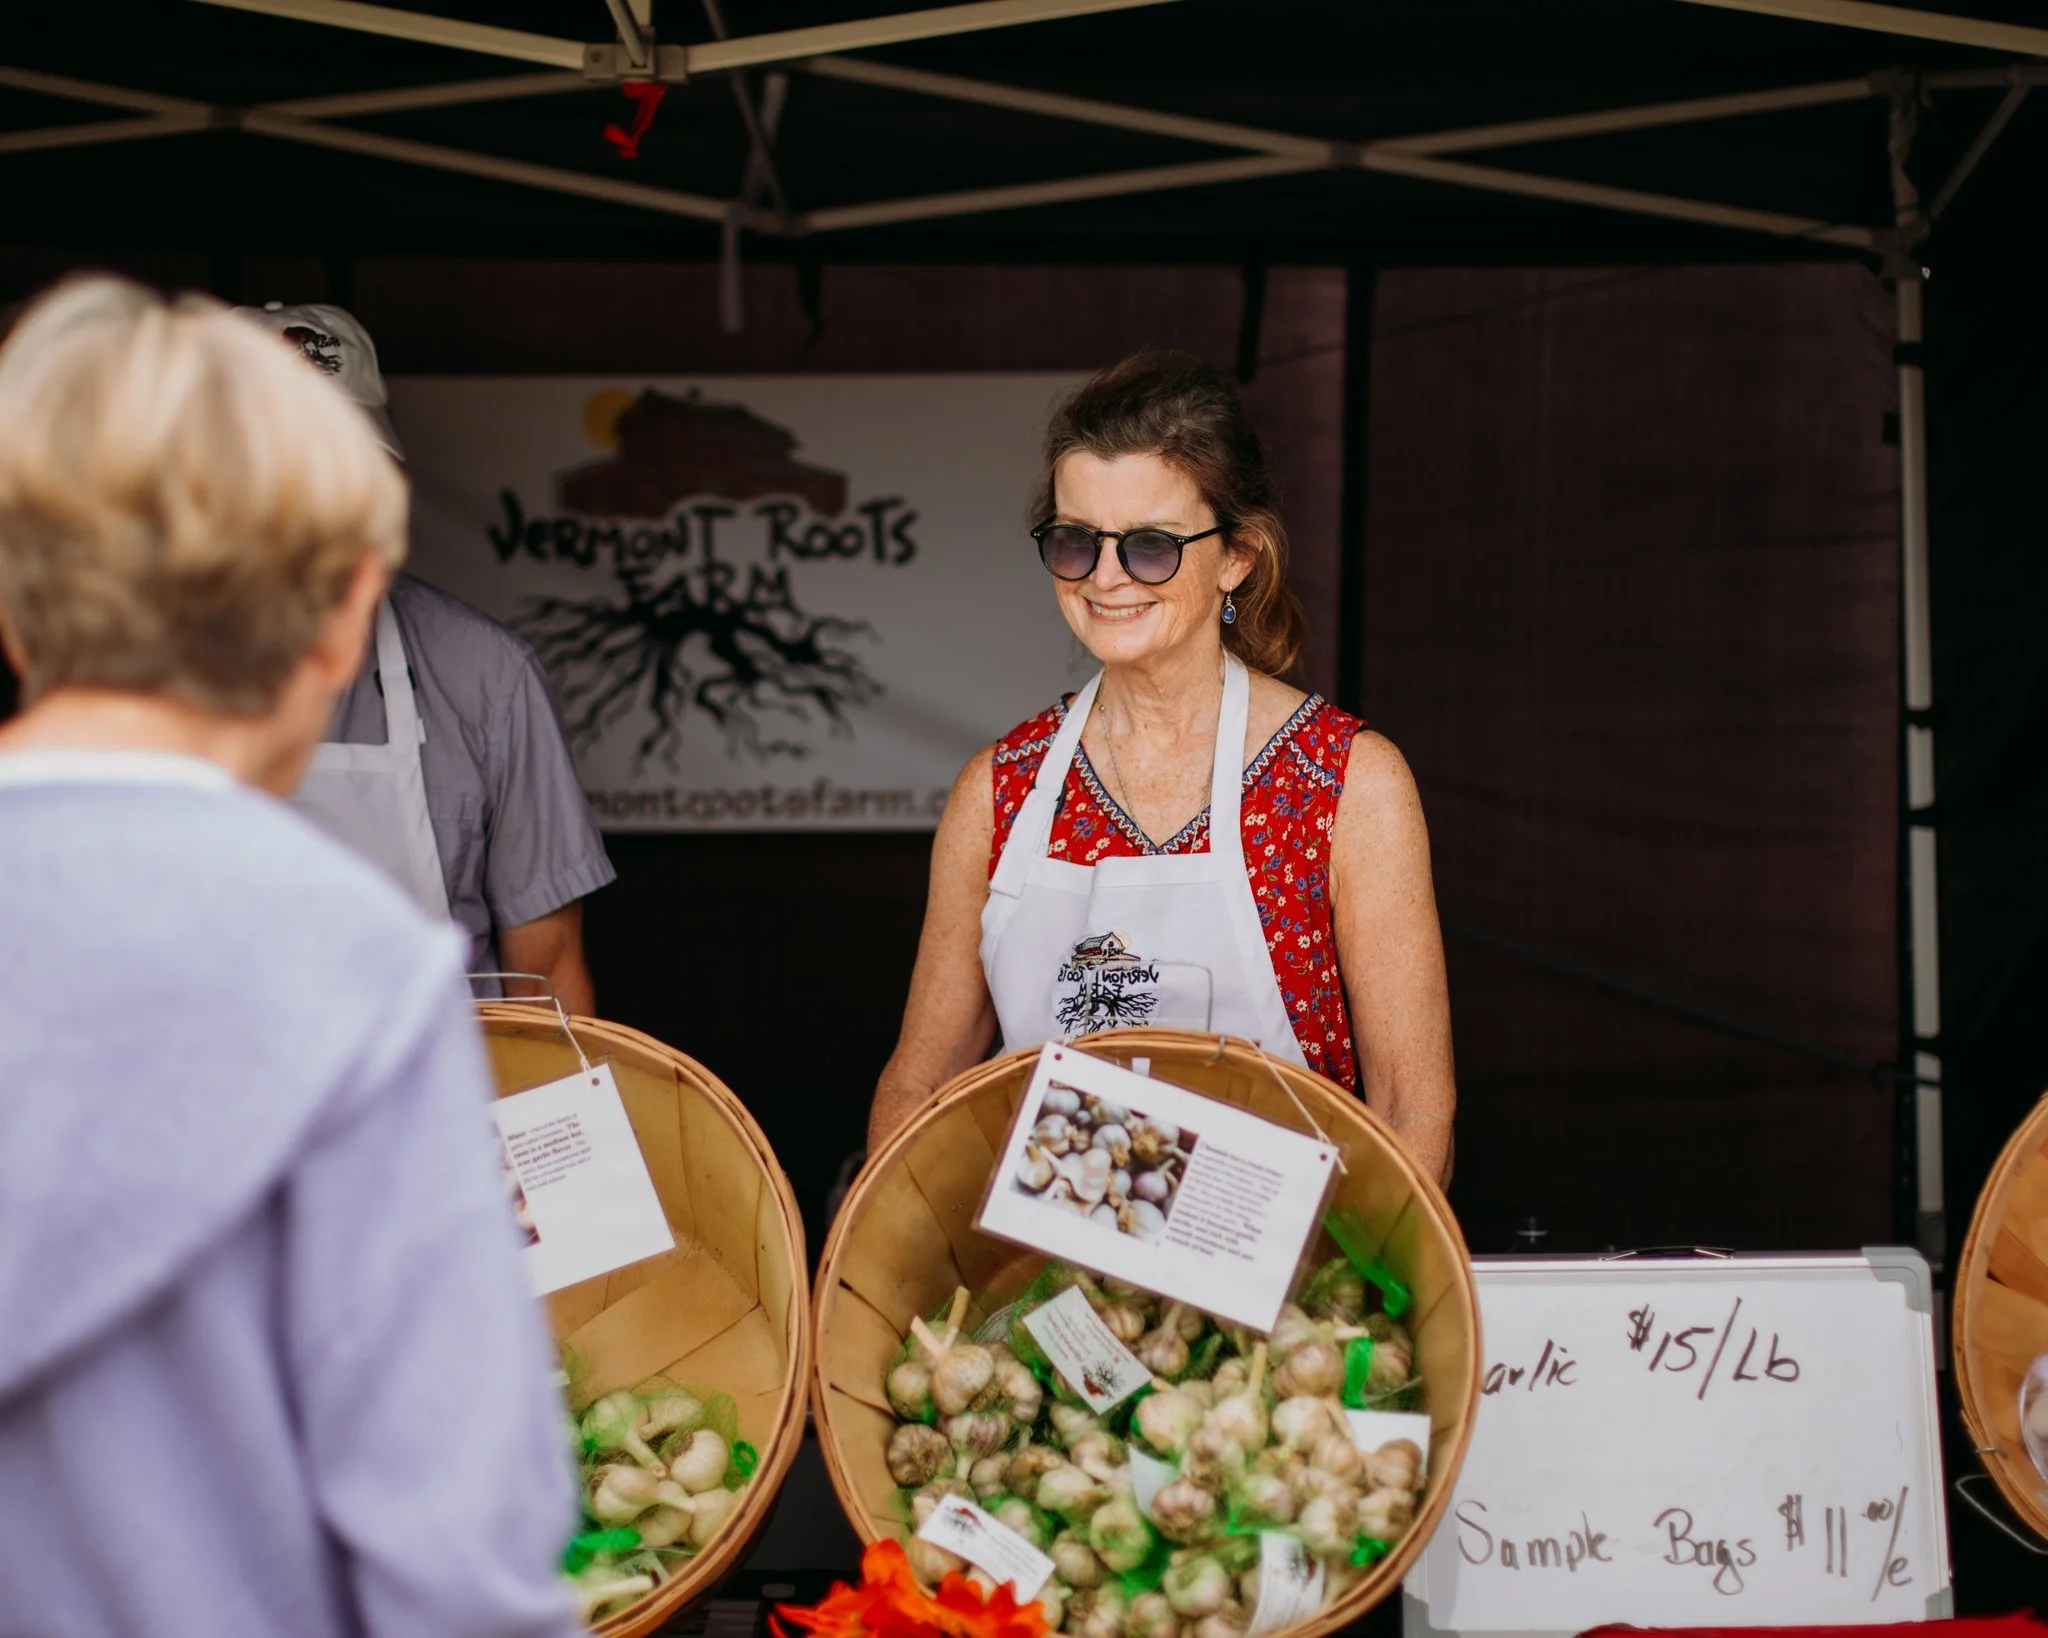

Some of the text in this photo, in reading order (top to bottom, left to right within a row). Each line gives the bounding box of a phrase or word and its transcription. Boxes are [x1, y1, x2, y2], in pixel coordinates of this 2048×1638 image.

[614, 561, 797, 607] FARM
[567, 1121, 580, 1129] The
[1482, 1339, 1578, 1396] arlic
[1455, 1500, 1614, 1573] Sample
[1653, 1507, 1758, 1596] Bags
